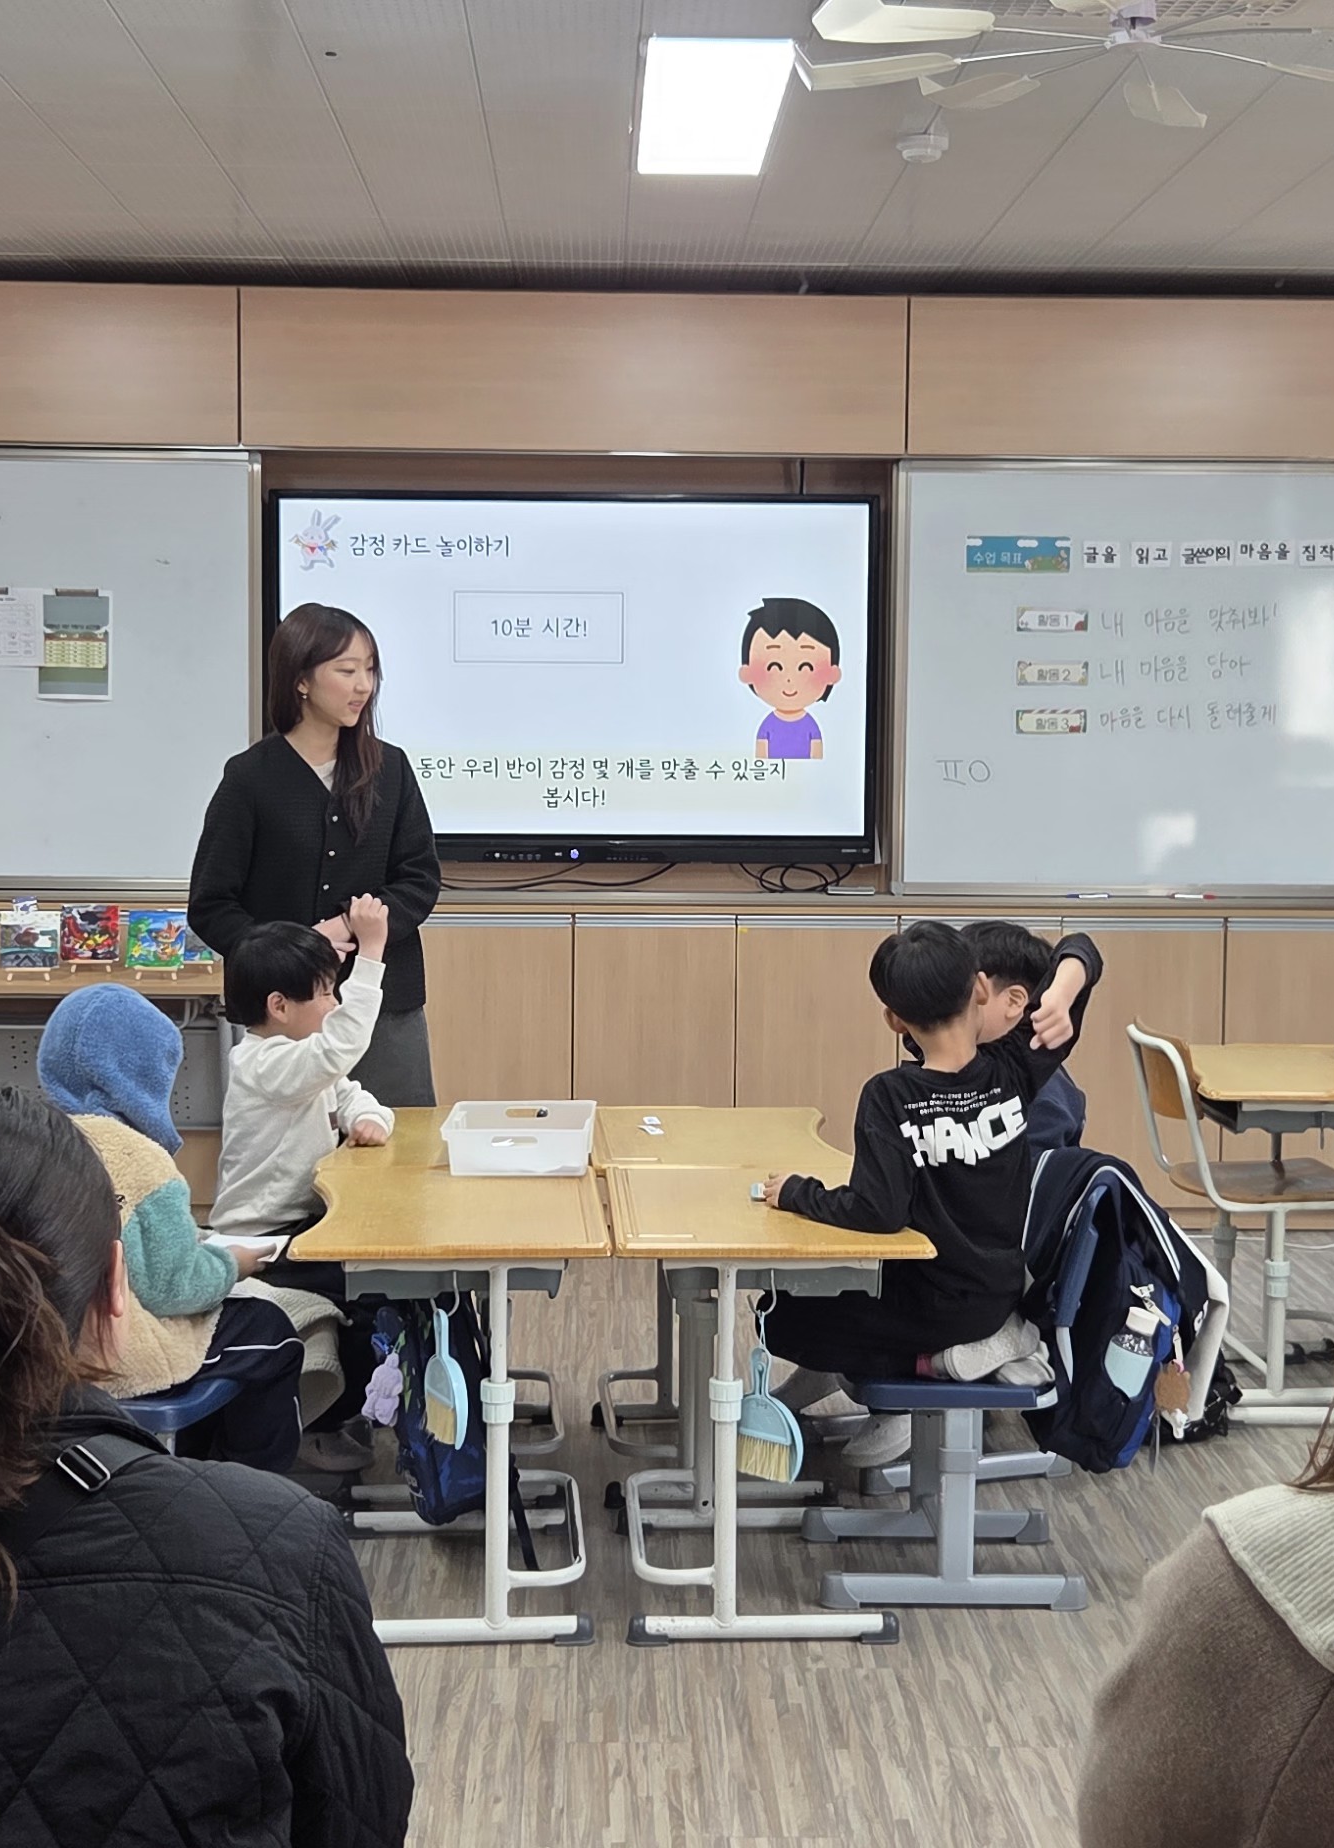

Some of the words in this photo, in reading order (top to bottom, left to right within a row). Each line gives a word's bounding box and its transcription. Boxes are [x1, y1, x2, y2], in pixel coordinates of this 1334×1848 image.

[349, 534, 386, 557] 감정
[392, 534, 432, 557] 카드
[435, 535, 511, 557] 놀이하기
[1083, 546, 1118, 565] 글을
[1135, 547, 1169, 565] 읽고
[1239, 542, 1291, 561] 마음을
[972, 551, 997, 566] 수업
[490, 618, 533, 638] 10분
[541, 617, 588, 639] 시간!
[1101, 609, 1125, 638] 내
[1144, 607, 1191, 634] 마음을
[1062, 668, 1071, 681] 2
[1099, 659, 1125, 687] 내
[1140, 655, 1189, 683] 마음을
[1100, 706, 1146, 733] 마음을
[1157, 704, 1191, 729] 다시
[417, 757, 456, 779] 동안
[462, 757, 499, 779] 우리
[506, 757, 542, 779] 반이
[549, 757, 585, 780] 감정
[592, 757, 610, 780] 몇
[617, 758, 655, 780] 개를
[661, 757, 700, 781] 맞출
[705, 760, 726, 780] 수
[732, 758, 786, 781] 있을지
[542, 786, 606, 809] 봅시다!
